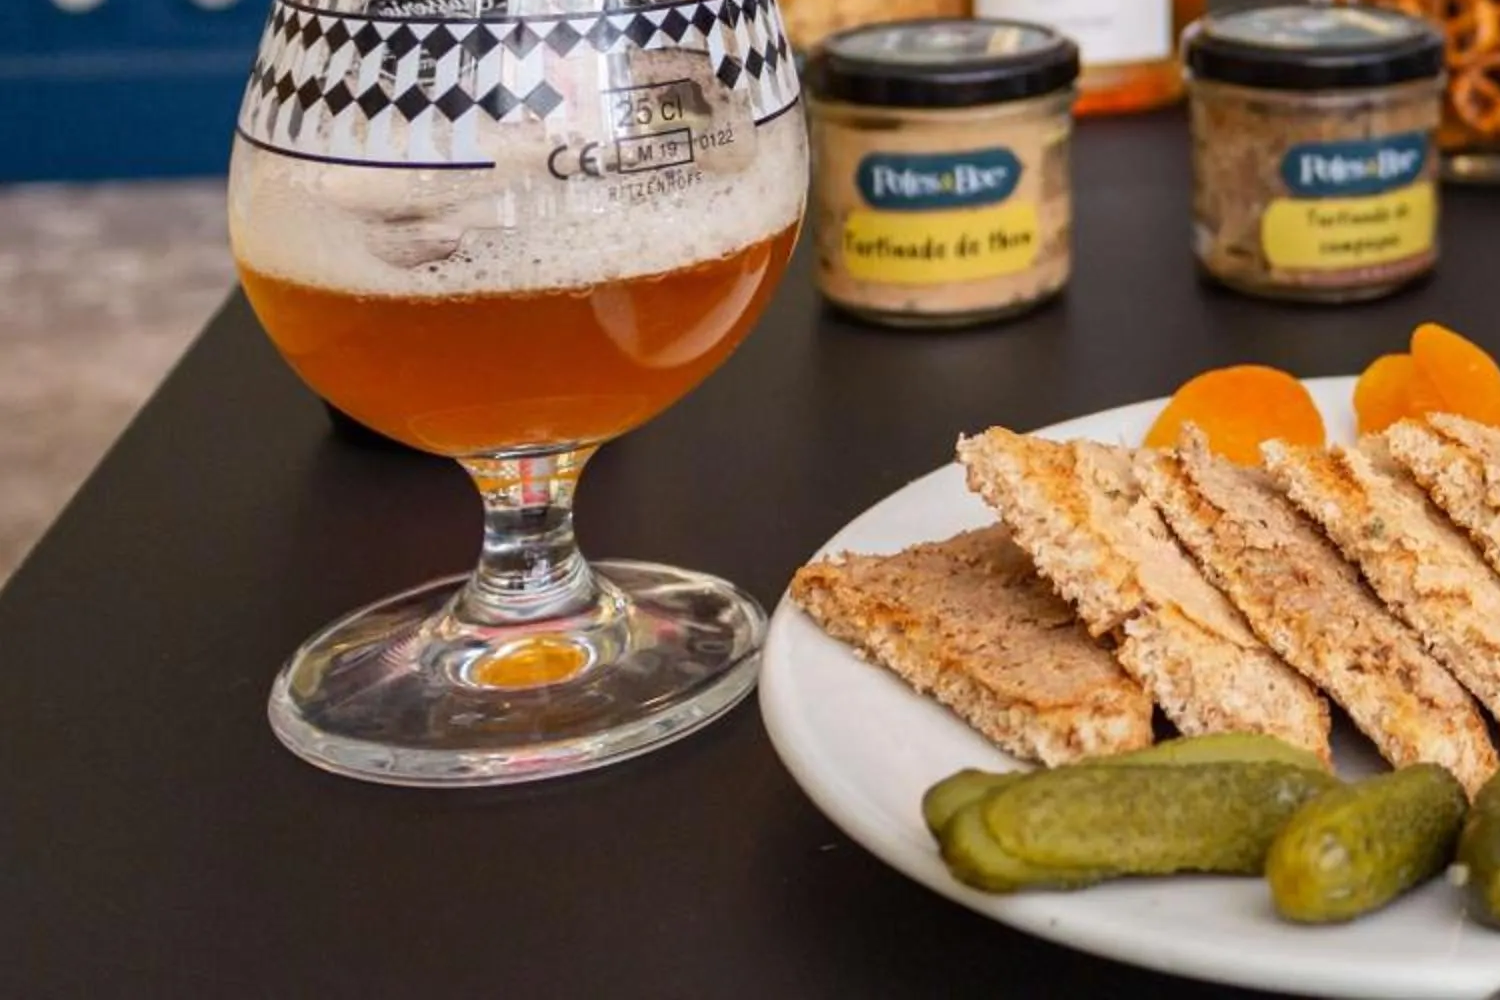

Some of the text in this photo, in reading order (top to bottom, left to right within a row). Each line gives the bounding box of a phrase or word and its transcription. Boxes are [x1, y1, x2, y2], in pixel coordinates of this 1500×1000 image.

[617, 98, 653, 126] 25
[700, 129, 734, 150] 0122
[955, 232, 980, 257] de
